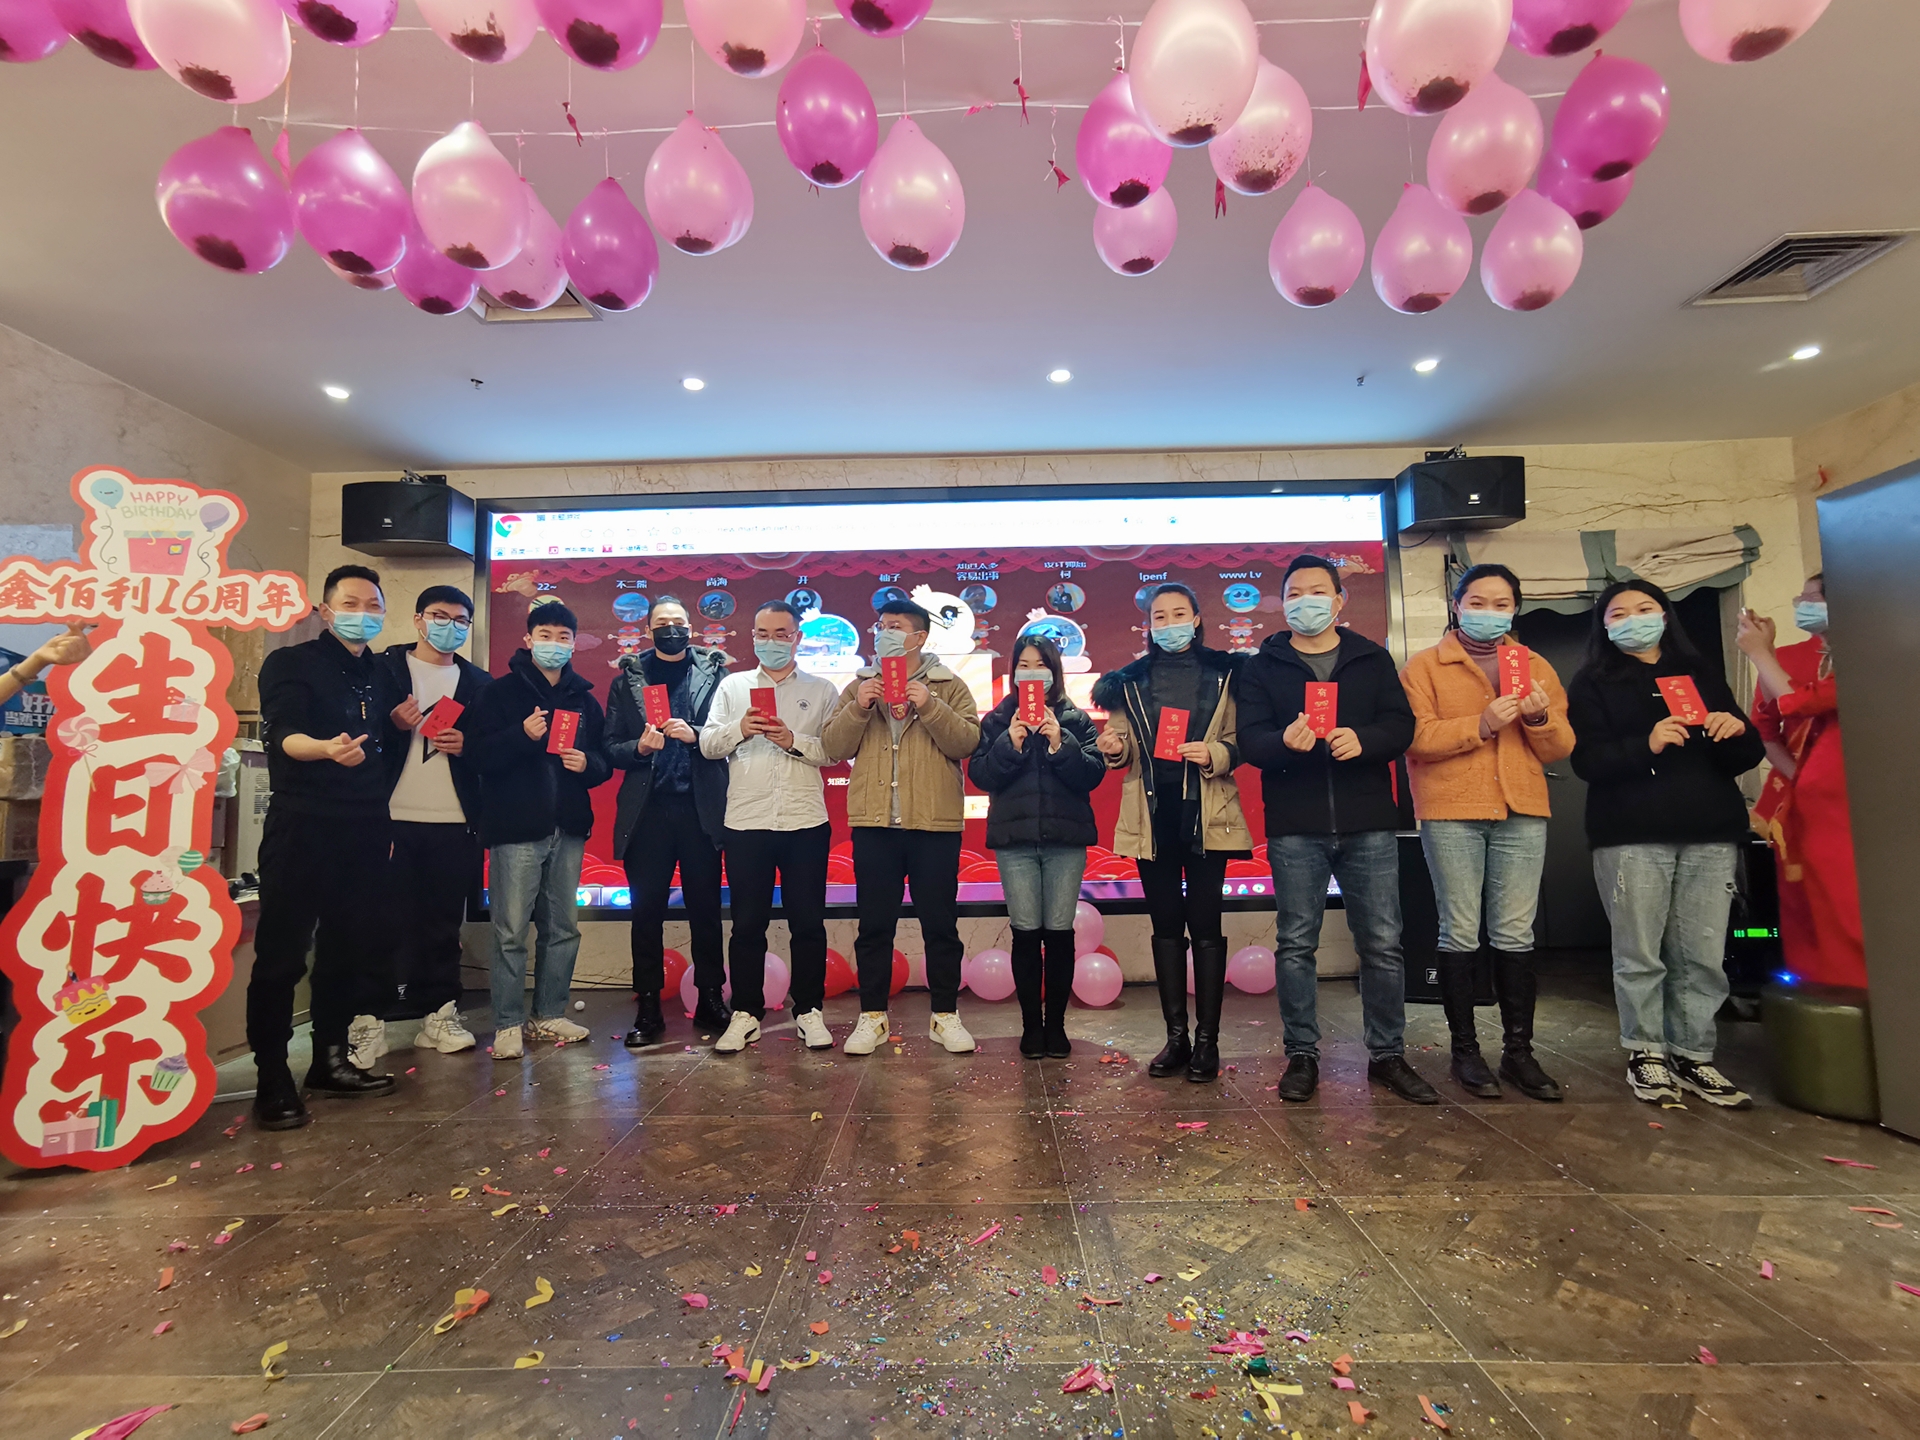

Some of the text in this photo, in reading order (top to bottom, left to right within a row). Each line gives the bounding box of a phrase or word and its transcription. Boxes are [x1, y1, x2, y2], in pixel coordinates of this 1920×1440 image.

[130, 491, 189, 506] HAPPY
[0, 568, 296, 619] 鑫佰利16周年
[41, 632, 202, 1130] 生日快乐
